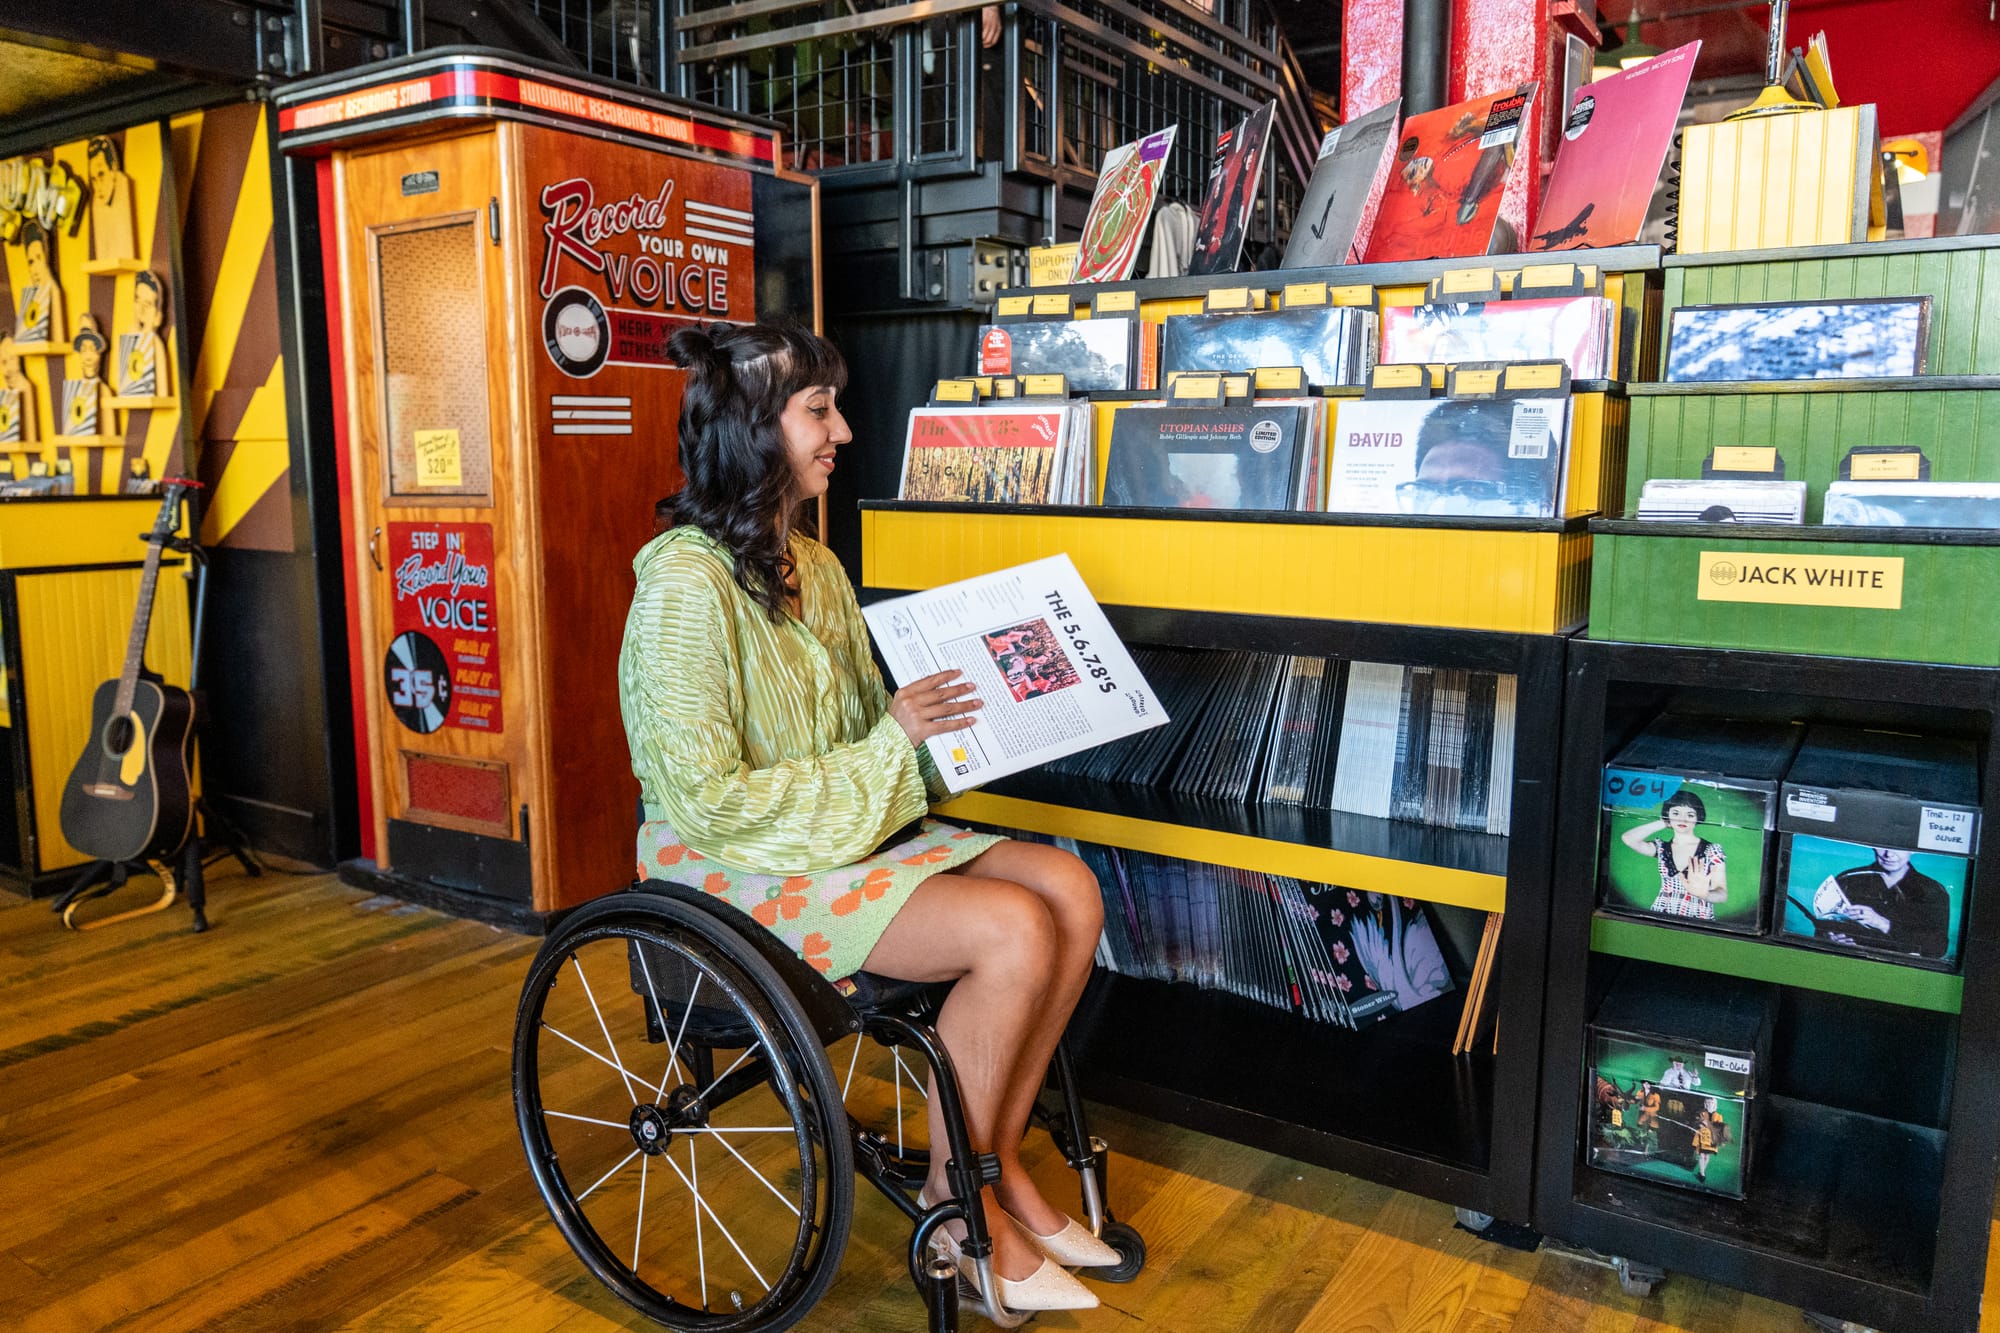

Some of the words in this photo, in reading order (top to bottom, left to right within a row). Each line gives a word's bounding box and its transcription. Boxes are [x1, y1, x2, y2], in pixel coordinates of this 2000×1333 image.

[519, 79, 586, 115] AUTOMATIC
[589, 101, 651, 133] RECORDING
[652, 116, 688, 141] STUDIO
[1492, 96, 1525, 113] trouble
[540, 177, 675, 298] Record
[637, 233, 684, 258] YOUR
[691, 243, 729, 265] OWN
[605, 253, 729, 311] VOICE
[618, 319, 652, 336] HEAR
[1159, 423, 1209, 433] UTOPIAN
[1211, 423, 1244, 433] ASHES
[1175, 433, 1198, 441] Gillespie
[1348, 432, 1403, 448] DAVID
[411, 531, 438, 550] STEP
[396, 550, 454, 601] Record
[450, 553, 488, 597] Your
[1739, 566, 1797, 585] JACK
[1804, 568, 1885, 589] WHITE
[418, 596, 489, 632] VOICE
[1045, 590, 1073, 620] THE
[1063, 623, 1117, 694] 5.6.7.8'S
[1608, 776, 1665, 799] 064
[1929, 822, 1956, 832] EDGAR
[1935, 834, 1964, 844] OLIVER
[1351, 1000, 1376, 1014] Stoner
[1376, 991, 1397, 1005] Witch
